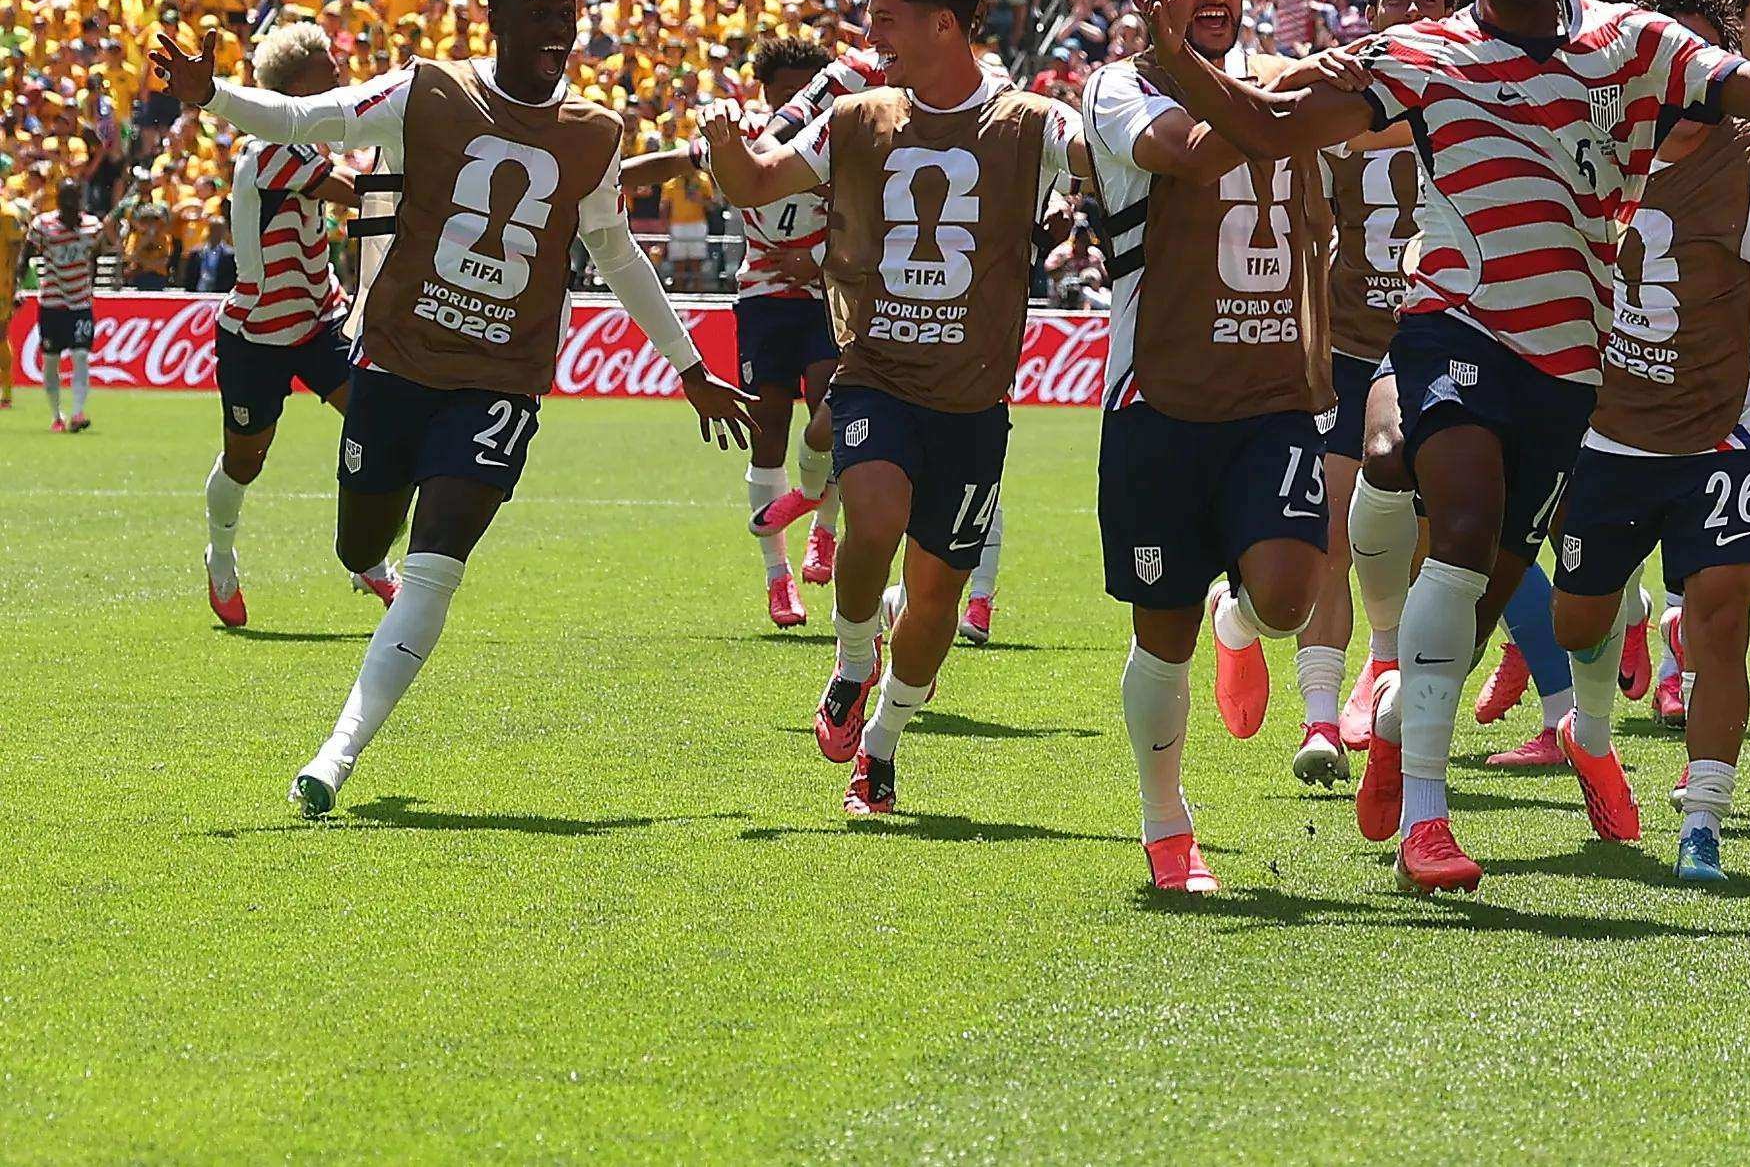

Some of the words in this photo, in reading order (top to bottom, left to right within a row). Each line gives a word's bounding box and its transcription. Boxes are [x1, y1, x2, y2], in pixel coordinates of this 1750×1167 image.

[1591, 87, 1618, 107] USA
[777, 203, 798, 236] 4
[459, 258, 503, 285] FIFA
[1247, 257, 1280, 275] FIFA
[903, 269, 947, 287] FIFA
[1365, 276, 1407, 288] WOR
[423, 282, 482, 311] WORLD
[482, 303, 517, 321] CUP
[1216, 299, 1270, 315] WORLD
[1273, 299, 1293, 314] CUP
[1367, 290, 1404, 309] 20
[874, 300, 934, 319] WORLD
[935, 305, 968, 320] CUP
[414, 297, 511, 344] 2026
[868, 318, 964, 344] 2026
[1213, 318, 1298, 344] 2026
[1646, 346, 1679, 363] CUP
[1451, 361, 1477, 373] USA
[1605, 346, 1675, 384] 026
[473, 400, 530, 455] 21
[847, 420, 867, 433] USA
[1279, 446, 1324, 504] 15
[952, 481, 999, 534] 14
[1564, 536, 1581, 551] USA
[1136, 548, 1160, 563] USA
